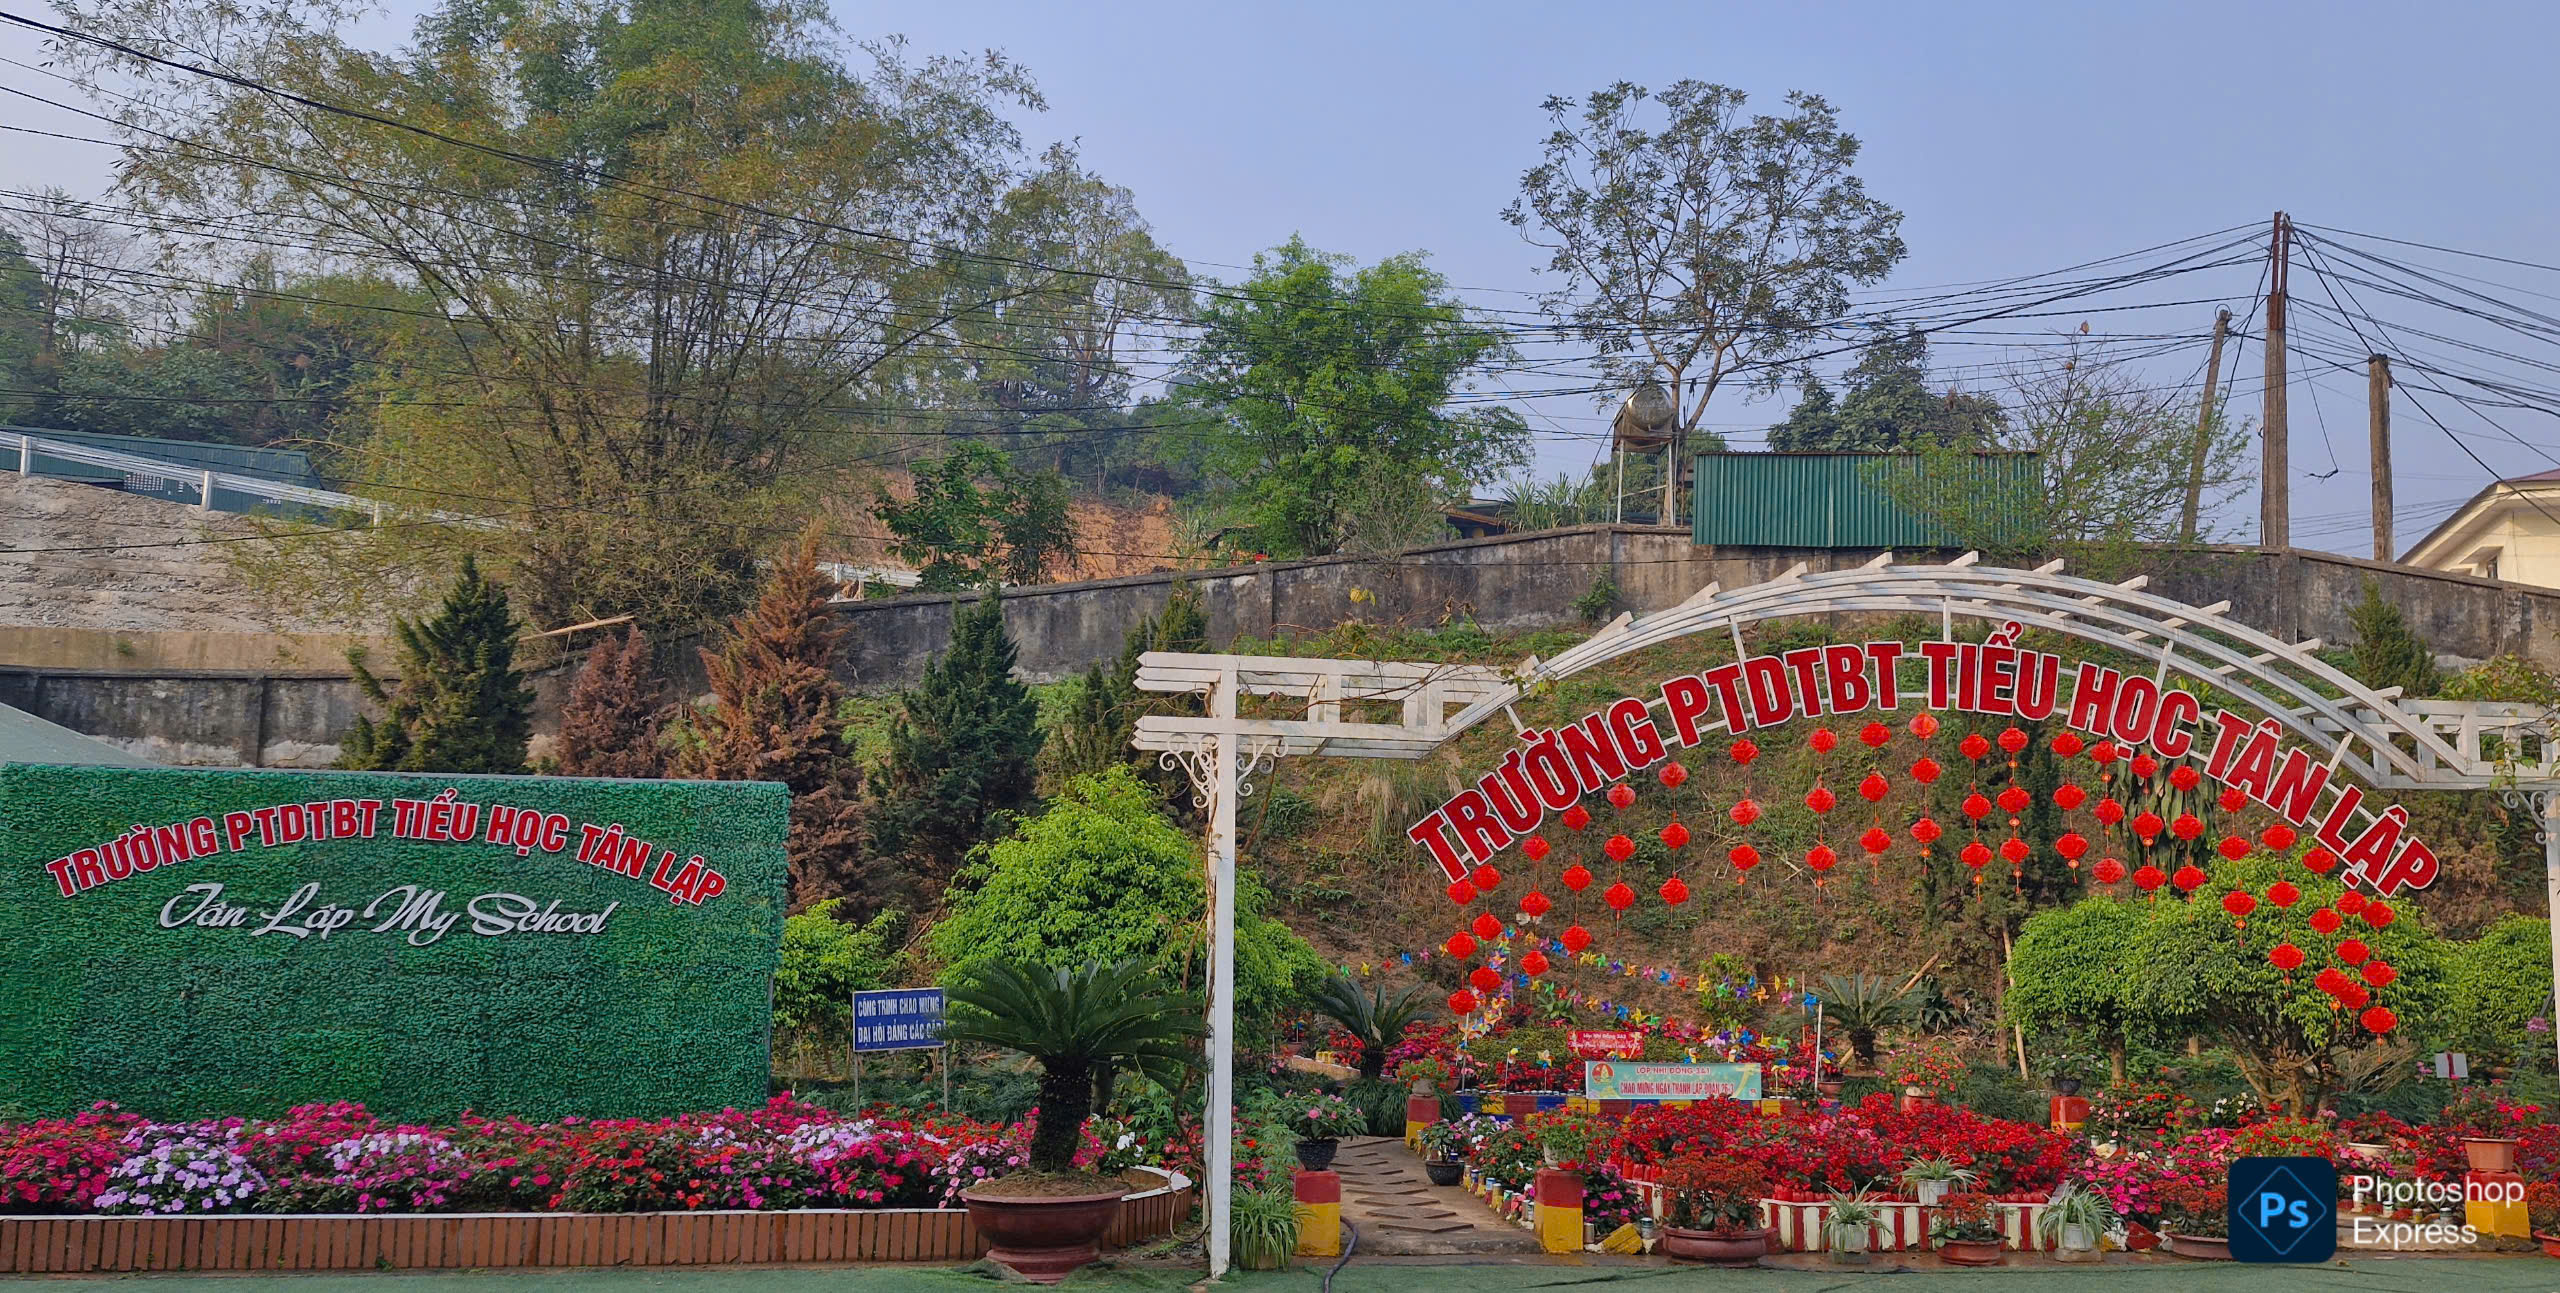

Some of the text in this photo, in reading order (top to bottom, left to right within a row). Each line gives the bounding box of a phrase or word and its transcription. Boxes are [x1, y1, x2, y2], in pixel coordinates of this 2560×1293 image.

[1407, 620, 2440, 898] TRƯỜNG PTDTBT TIỂU HỌC TÂN LẬP
[45, 787, 727, 907] TRƯỜNG PTDTBT TIỂU HỌC TÂN LẬP
[364, 884, 461, 947] My
[467, 892, 620, 937] School
[857, 997, 877, 1017] CÔNG
[877, 995, 898, 1016] TRÌNH
[918, 993, 940, 1014] MỪNG
[872, 1022, 886, 1046] HỘI
[886, 1018, 908, 1042] ĐẢNG
[909, 1019, 925, 1040] CÁC
[1636, 1065, 1650, 1074] LỚP
[1654, 1066, 1667, 1074] NHI
